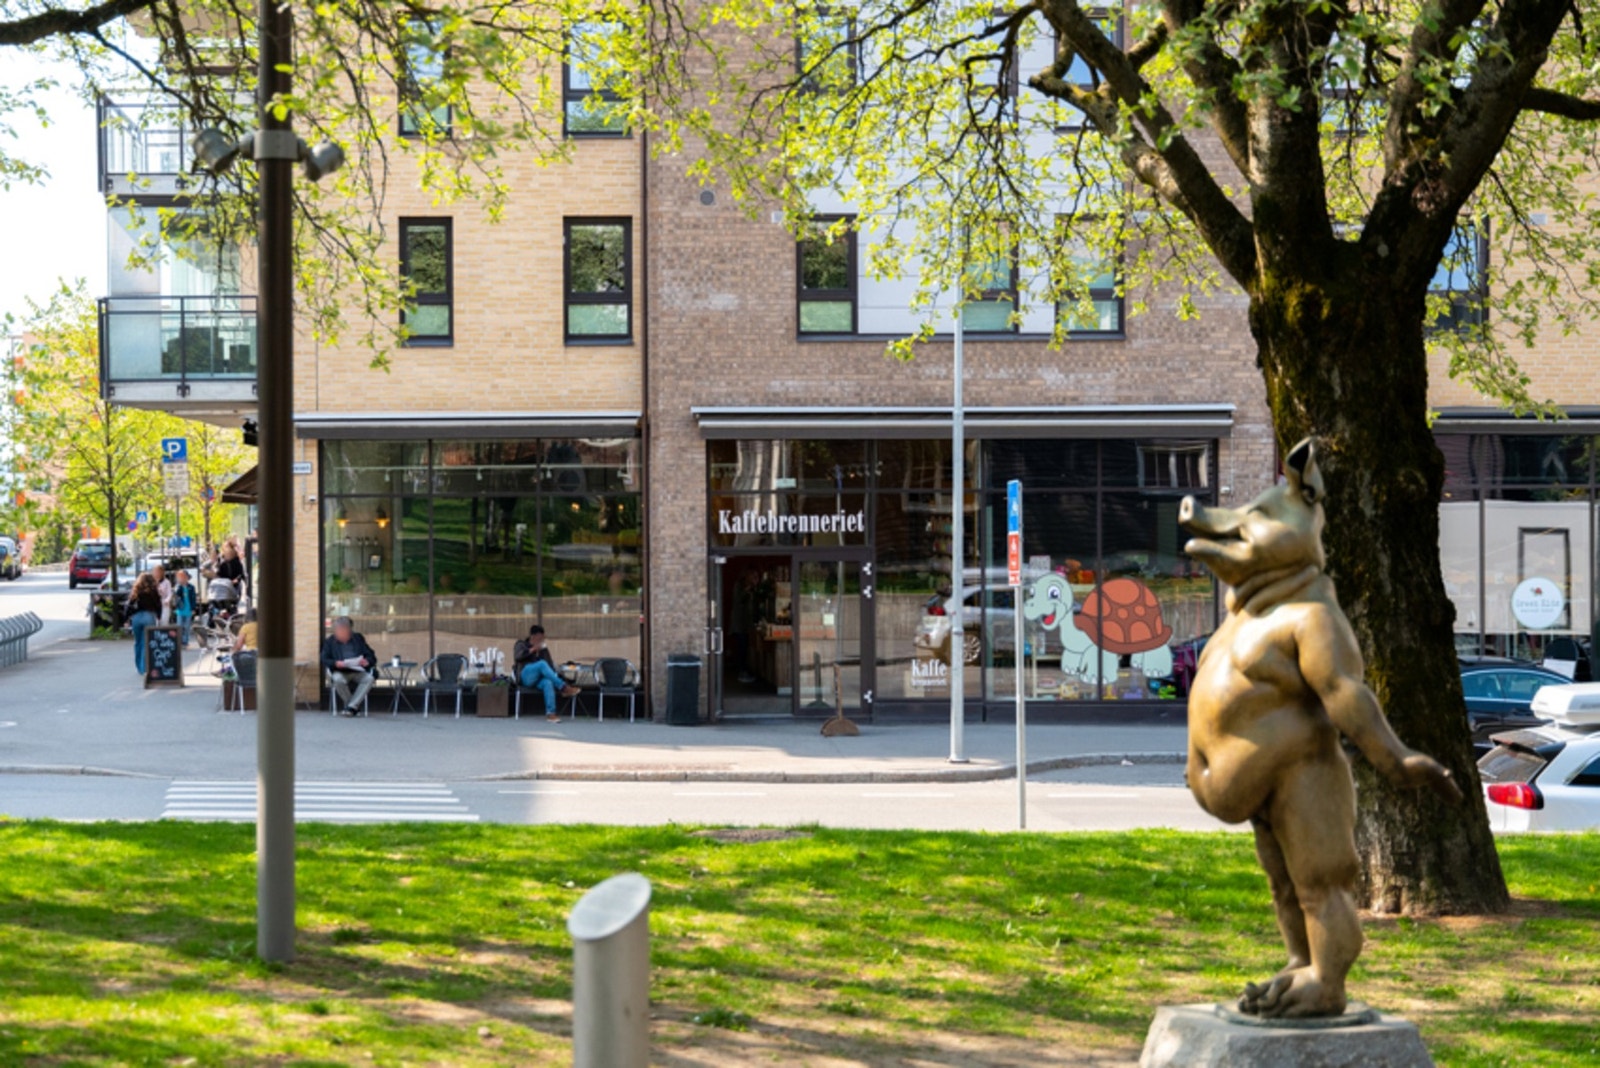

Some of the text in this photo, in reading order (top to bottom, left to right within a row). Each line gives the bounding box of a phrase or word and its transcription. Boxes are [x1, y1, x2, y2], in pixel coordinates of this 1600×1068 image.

[167, 441, 182, 459] P
[718, 509, 865, 534] Kaffebrenneriet
[469, 647, 505, 664] Kaffe
[912, 659, 947, 677] Kaffe
